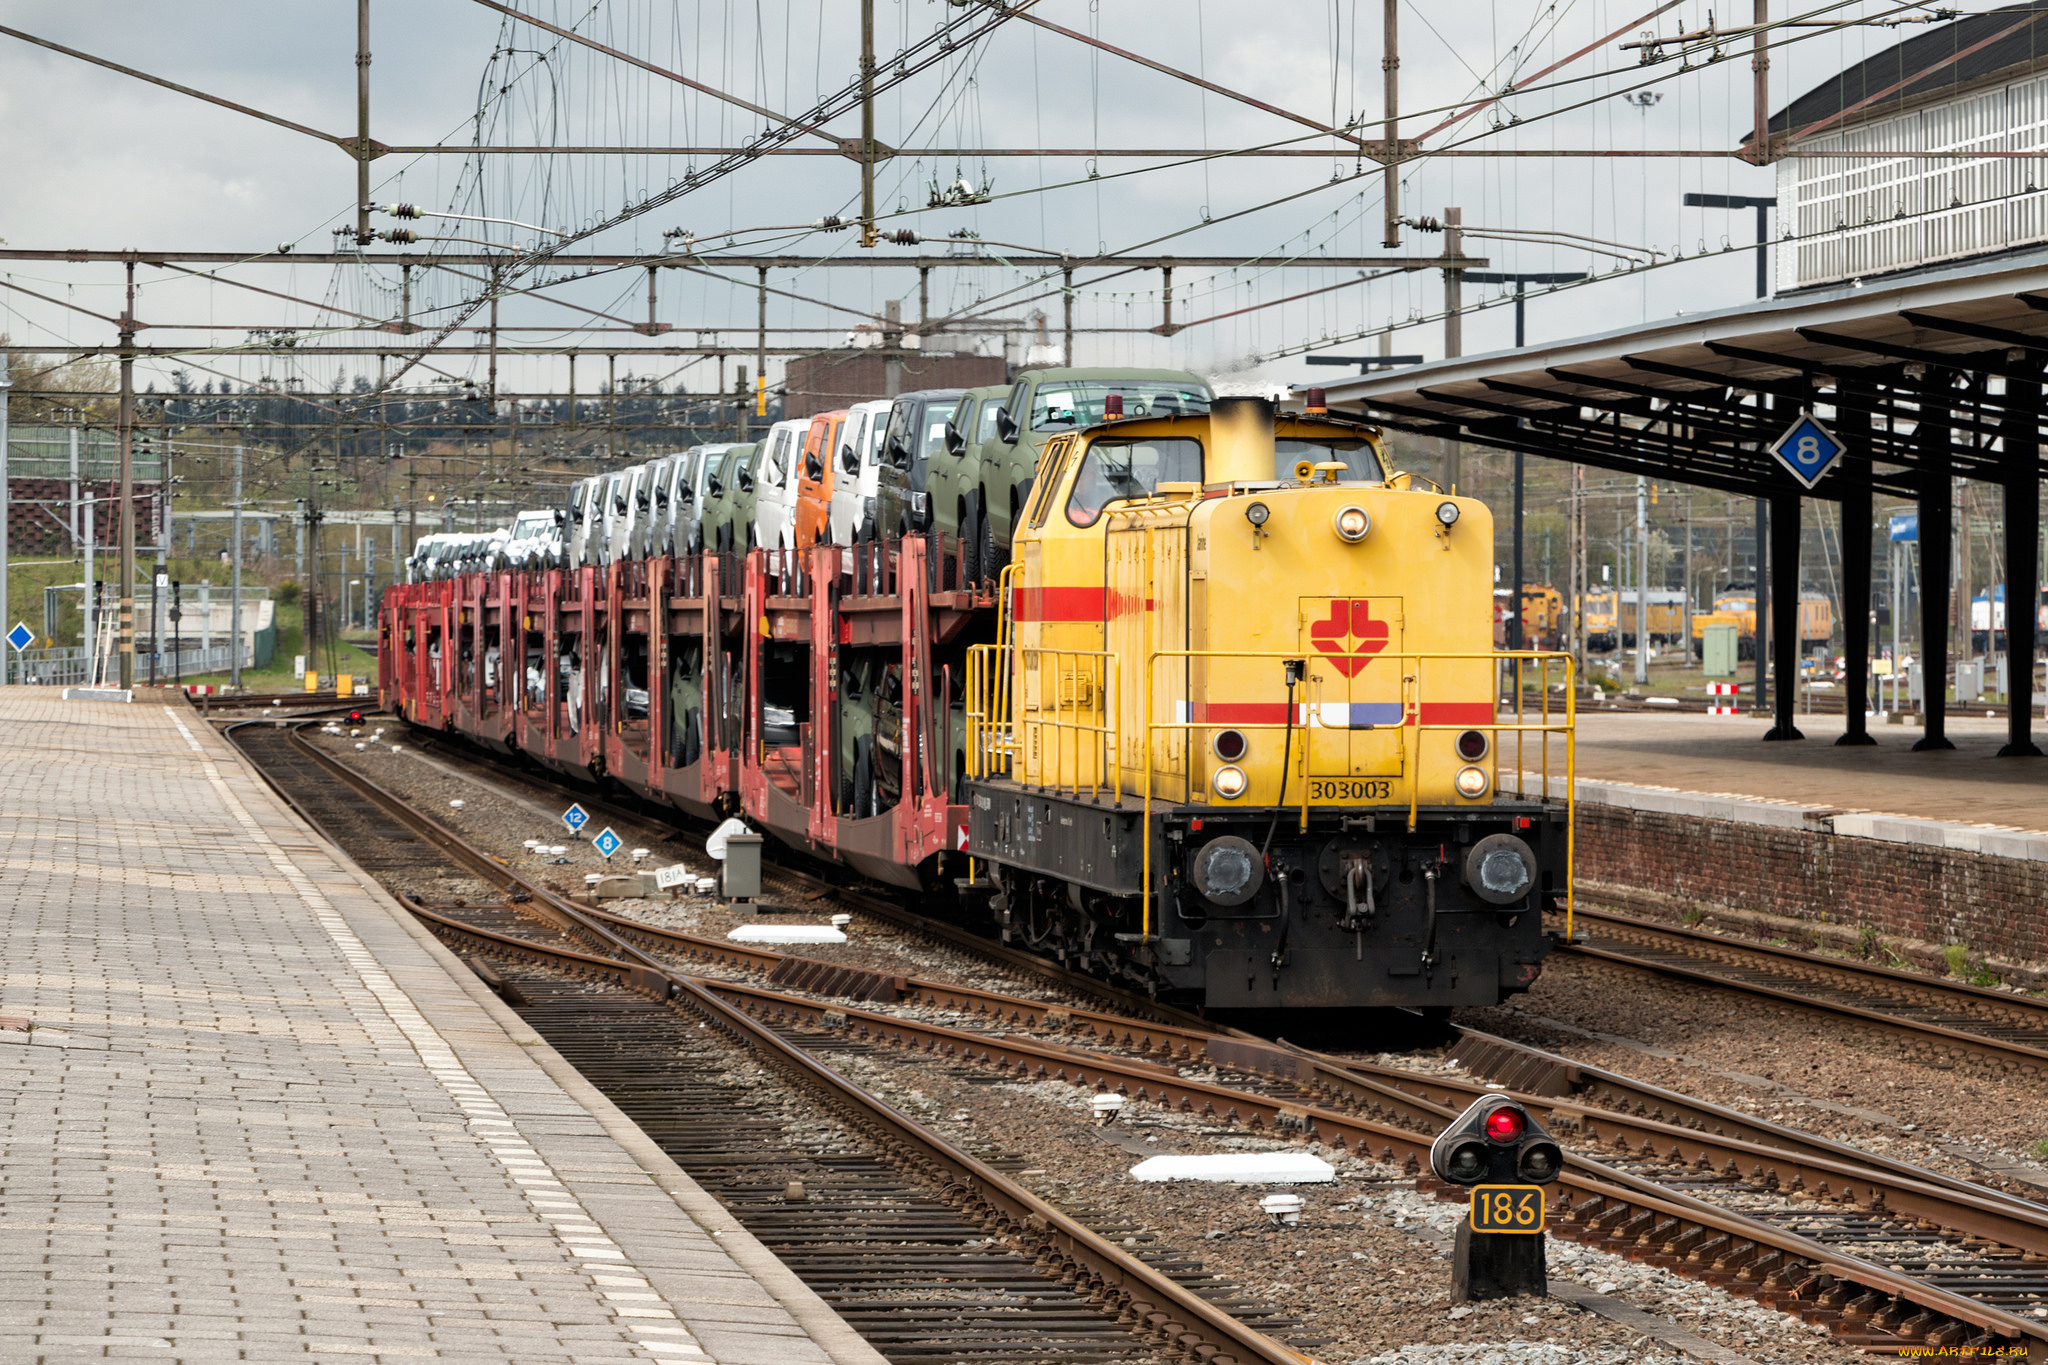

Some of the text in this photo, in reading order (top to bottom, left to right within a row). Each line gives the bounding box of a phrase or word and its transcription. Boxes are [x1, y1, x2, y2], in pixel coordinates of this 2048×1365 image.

[1797, 436, 1820, 464] 8
[1311, 781, 1390, 799] 303003
[569, 812, 582, 823] 12
[602, 836, 613, 850] 8
[660, 868, 684, 884] 181A
[1481, 1193, 1536, 1225] 186
